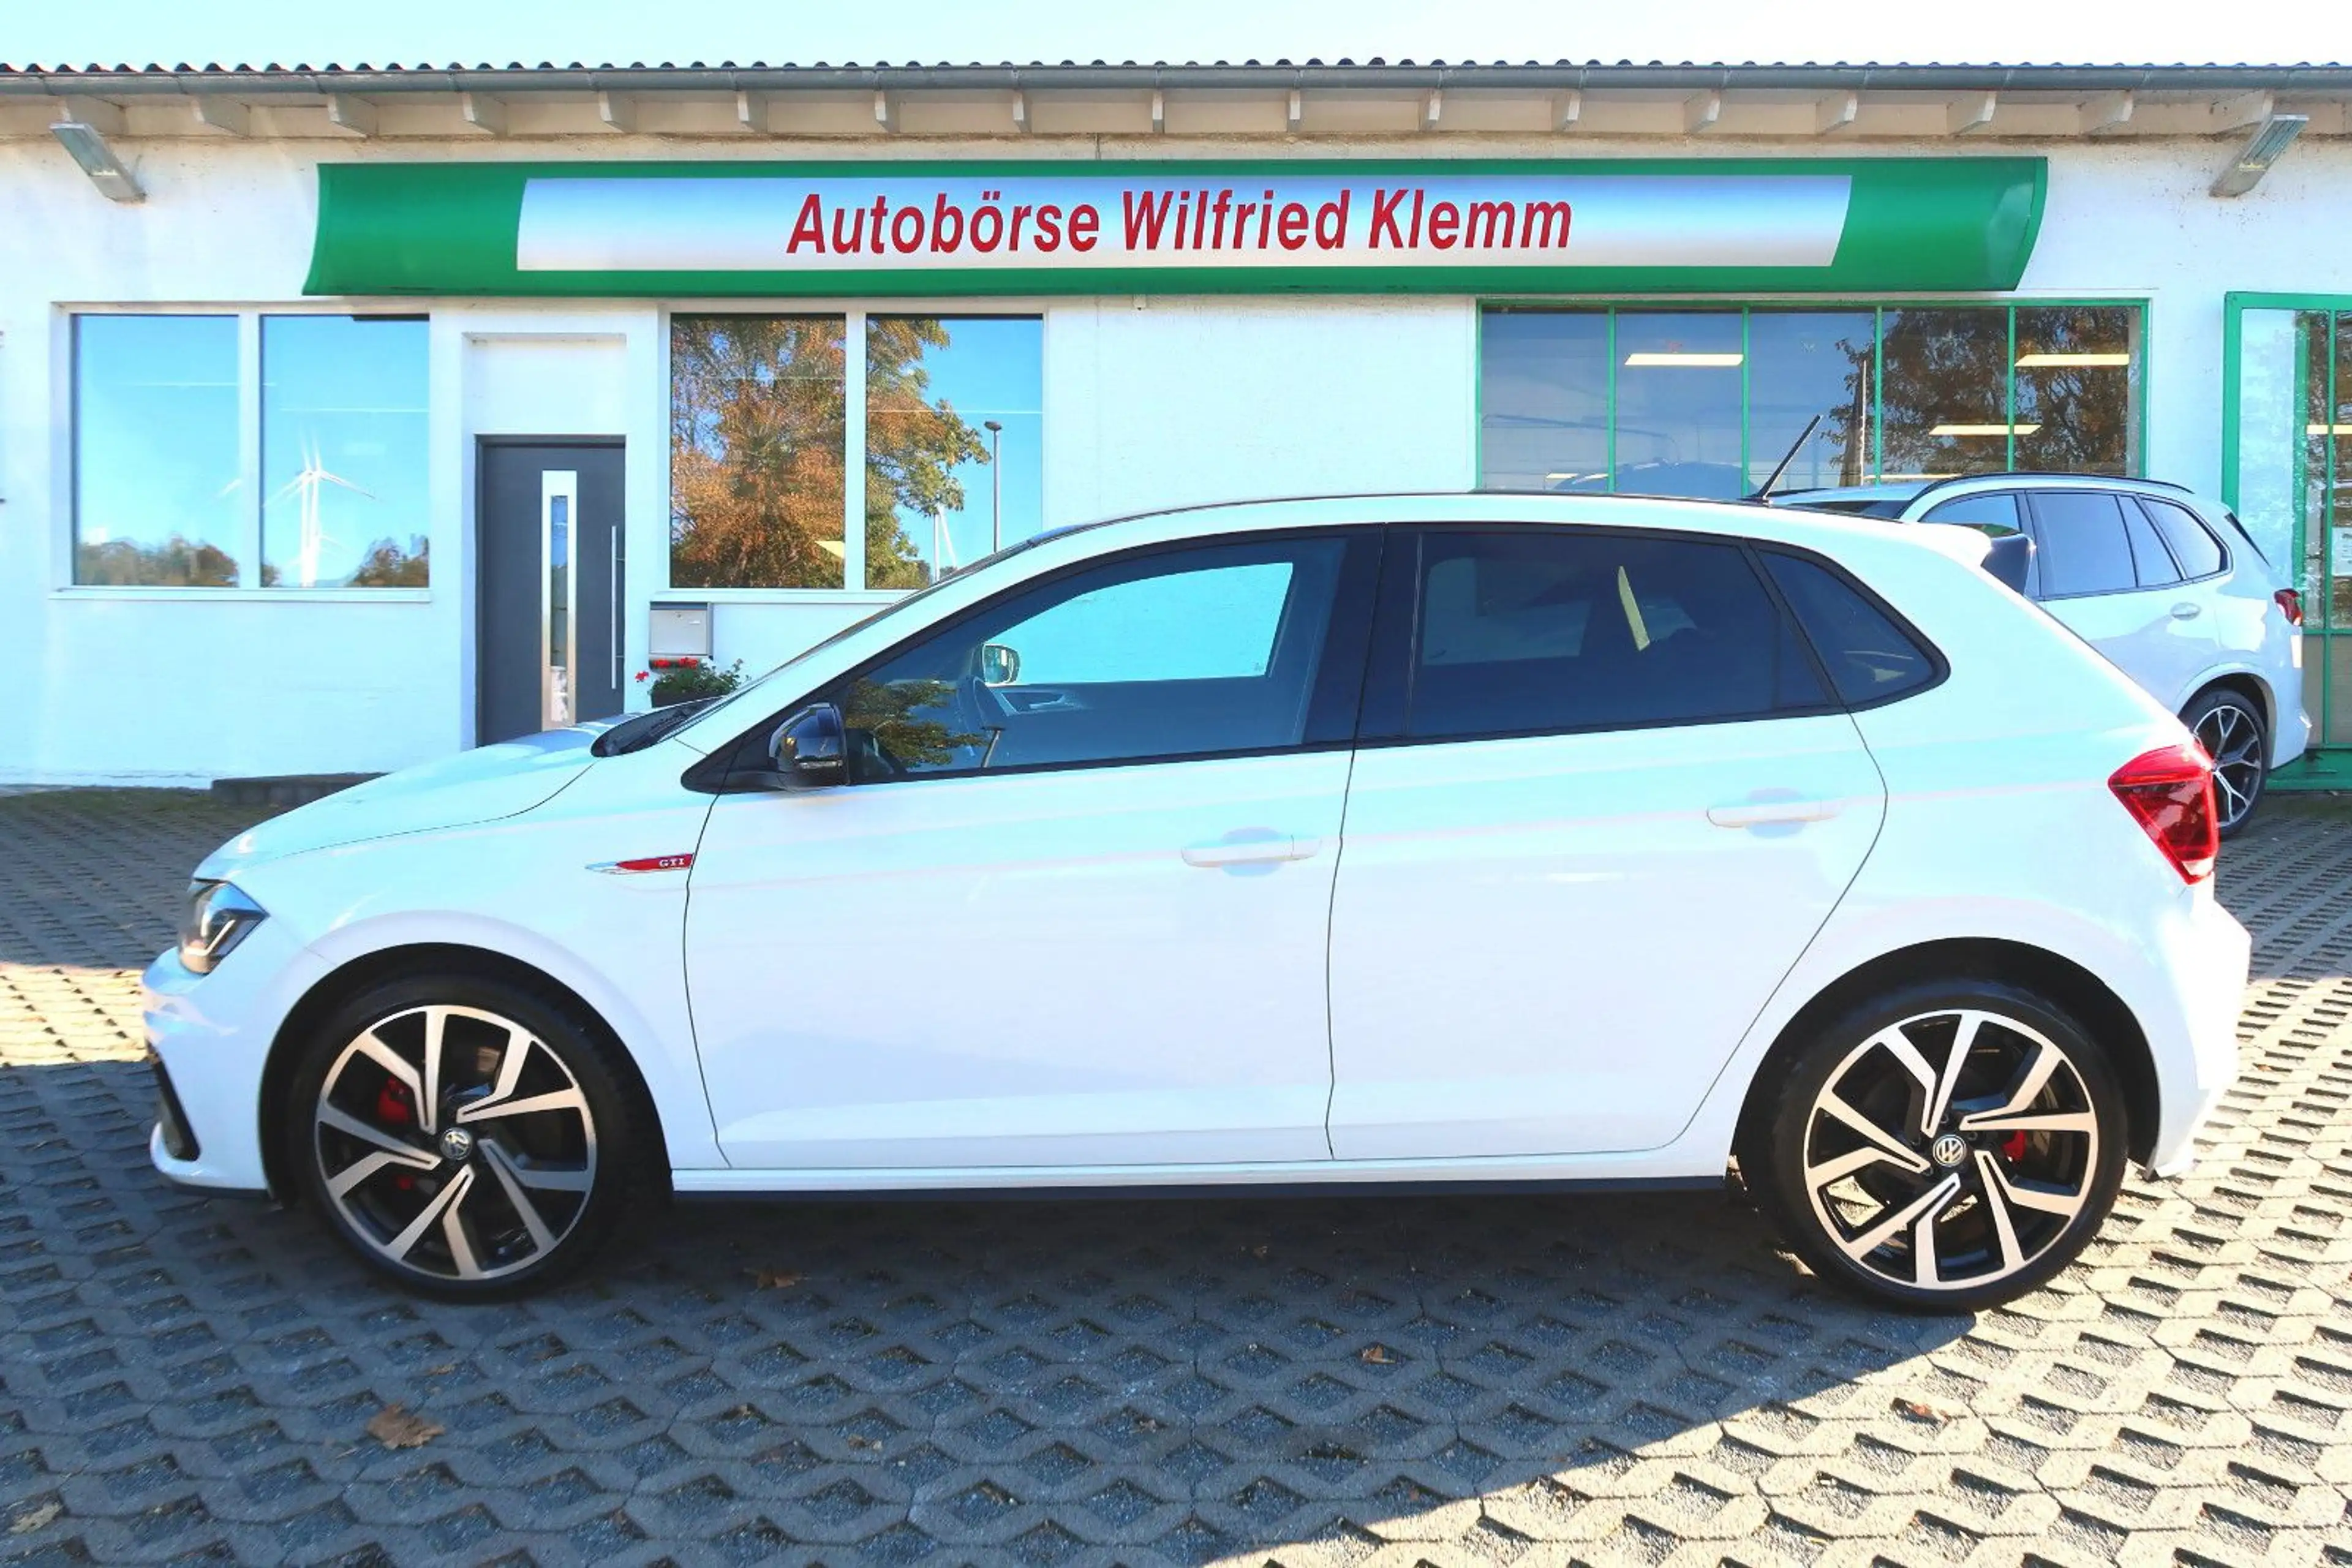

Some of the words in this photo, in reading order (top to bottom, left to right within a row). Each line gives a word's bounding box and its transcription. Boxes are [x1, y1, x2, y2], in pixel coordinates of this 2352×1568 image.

[786, 191, 1100, 254] Autobörse
[1123, 190, 1351, 251] Wilfried
[1369, 190, 1570, 250] Klemm
[660, 859, 684, 867] GTI
[1935, 1136, 1965, 1166] VW
